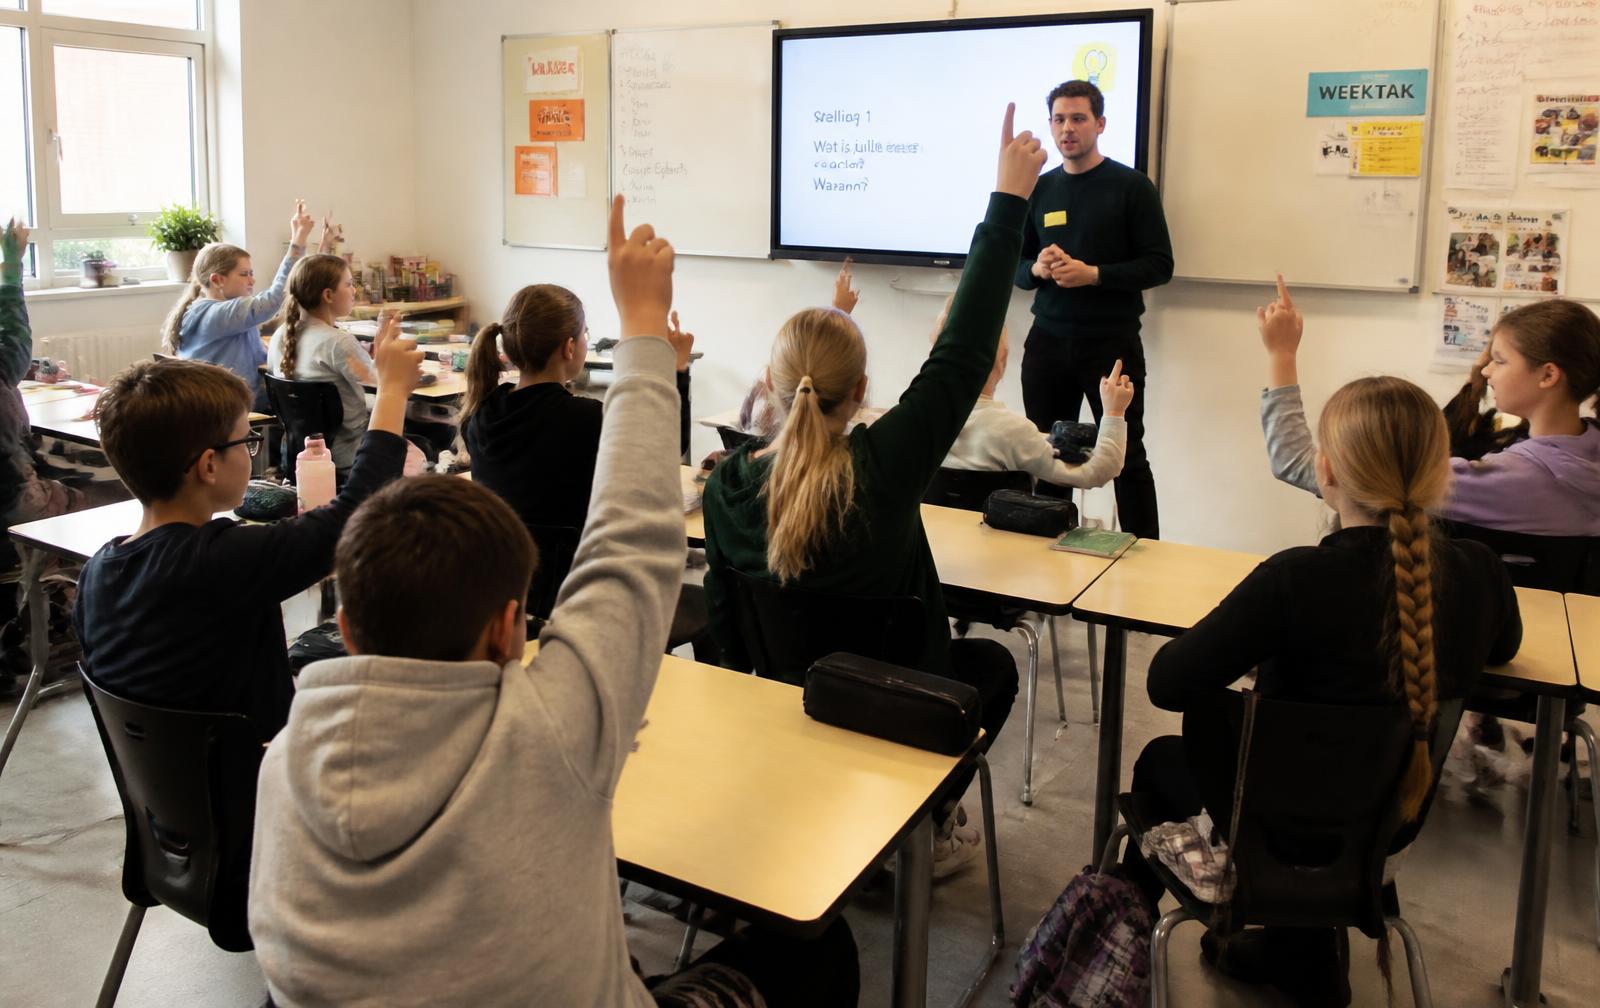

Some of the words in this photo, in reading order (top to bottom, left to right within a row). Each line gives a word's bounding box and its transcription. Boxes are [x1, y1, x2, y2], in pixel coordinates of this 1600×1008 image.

[1319, 83, 1415, 100] WEEKTAK
[813, 139, 838, 153] Wat
[841, 138, 851, 153] is
